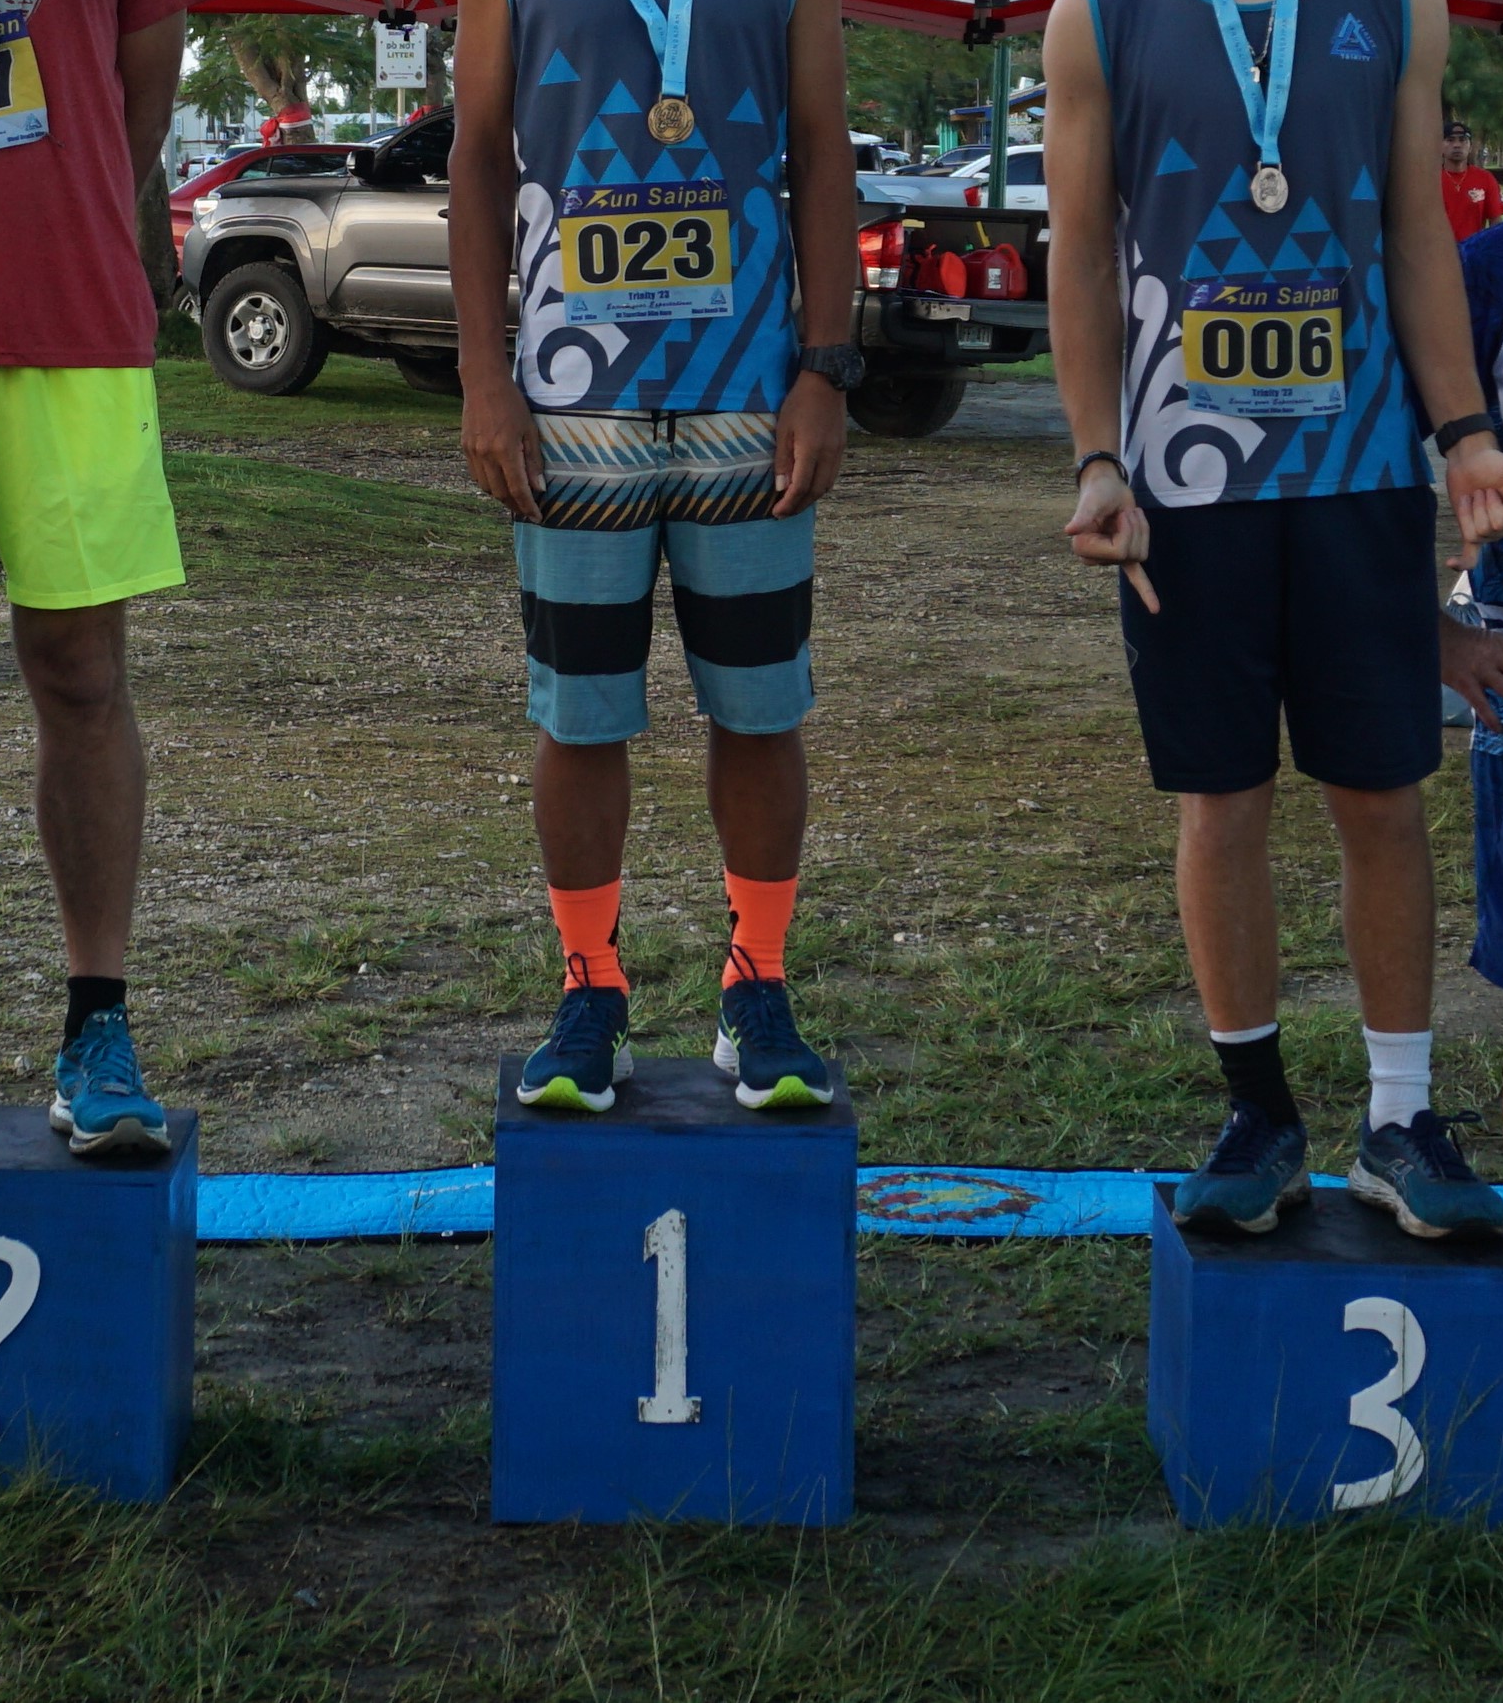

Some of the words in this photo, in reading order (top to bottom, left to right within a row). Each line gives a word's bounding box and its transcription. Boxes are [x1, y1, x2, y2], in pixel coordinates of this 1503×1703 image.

[399, 42, 415, 50] NOT
[648, 186, 723, 208] Saipan
[578, 216, 715, 286] 023
[628, 291, 655, 301] Trinity
[1277, 286, 1339, 307] Saipan
[1201, 315, 1333, 380] 006
[635, 1207, 702, 1425] 1
[1333, 1296, 1425, 1511] 3
